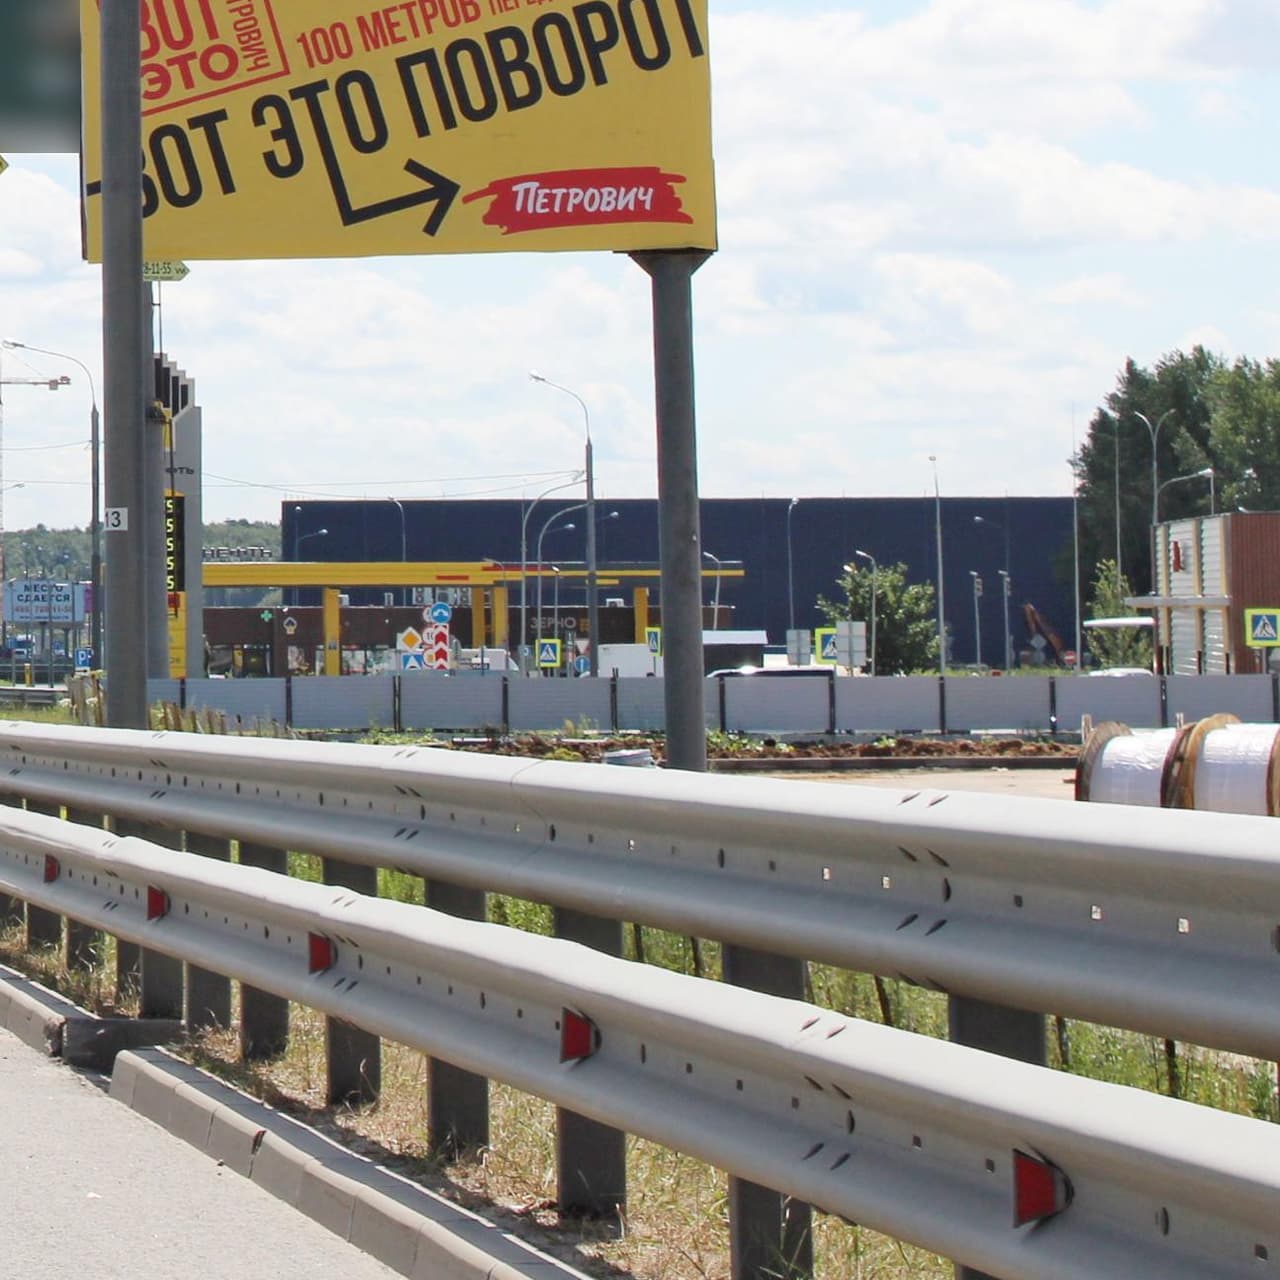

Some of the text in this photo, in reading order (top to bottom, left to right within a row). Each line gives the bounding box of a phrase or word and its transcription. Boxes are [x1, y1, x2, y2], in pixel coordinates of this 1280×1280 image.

[140, 43, 240, 101] ЭТО
[296, 21, 354, 69] 100
[251, 69, 390, 226] ЭТО
